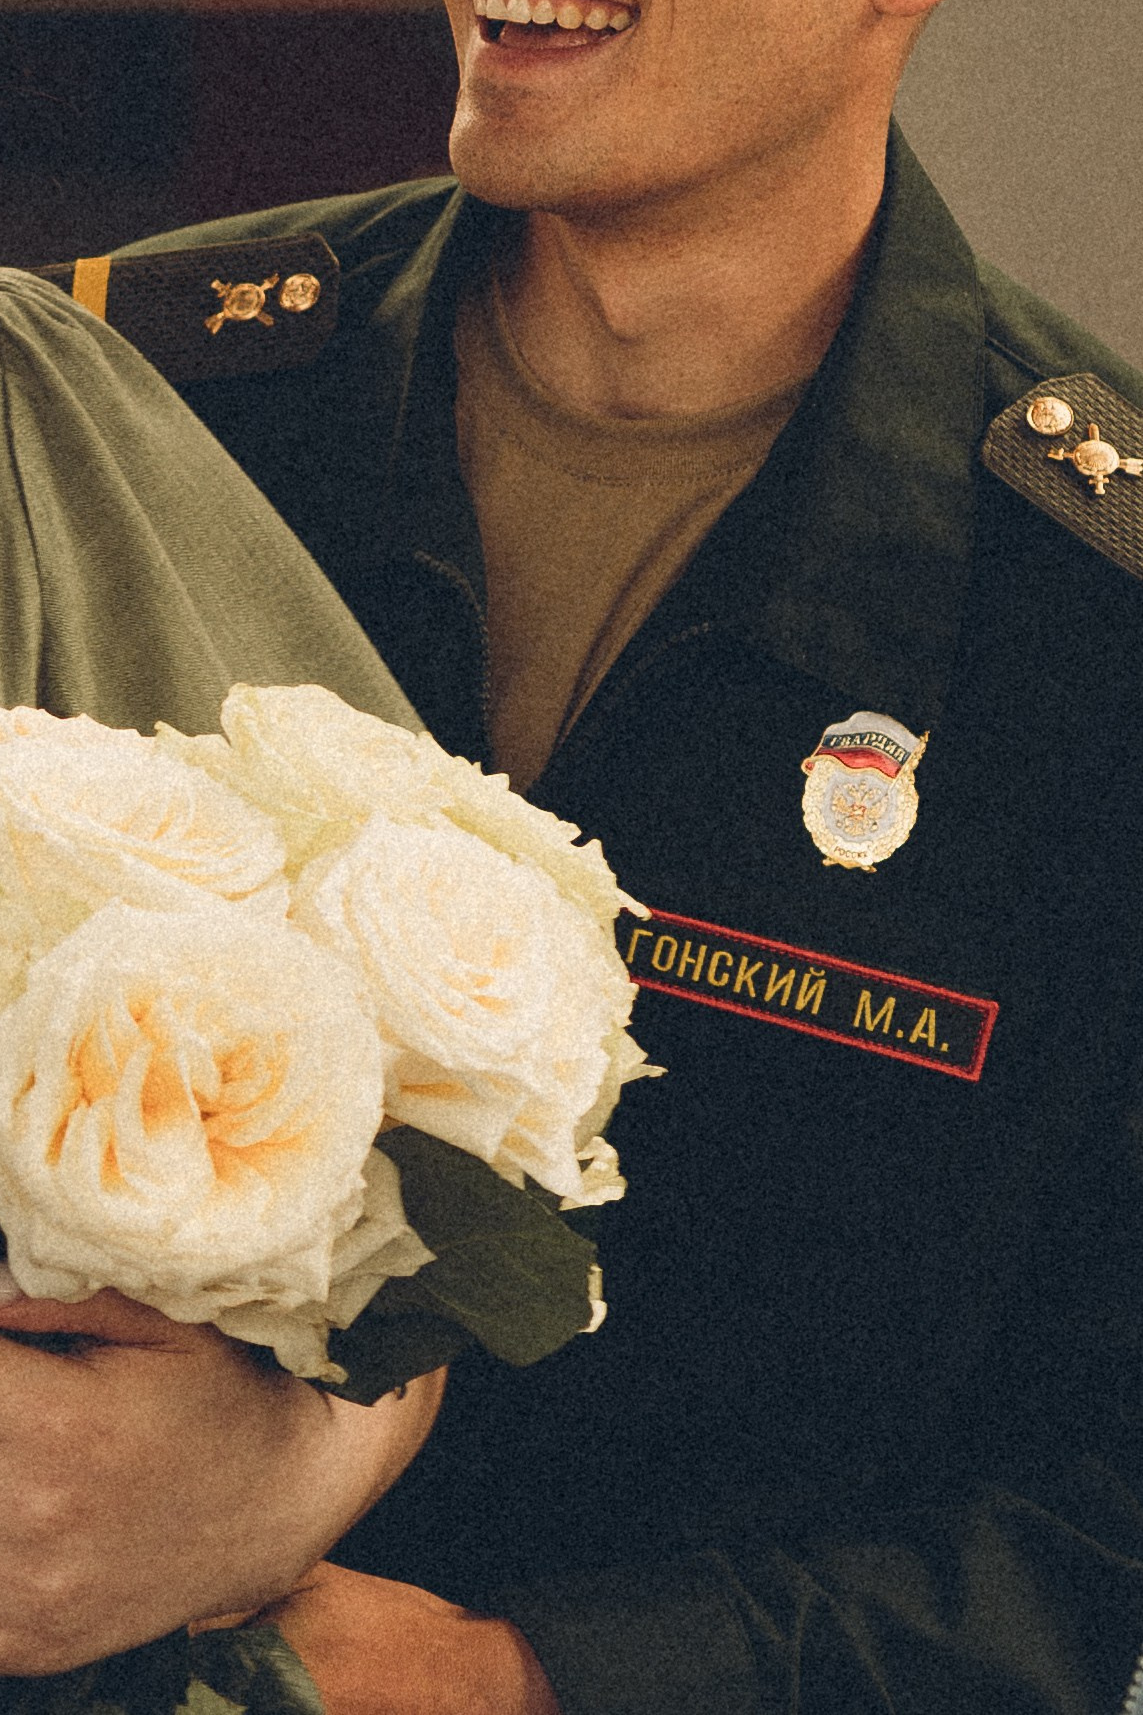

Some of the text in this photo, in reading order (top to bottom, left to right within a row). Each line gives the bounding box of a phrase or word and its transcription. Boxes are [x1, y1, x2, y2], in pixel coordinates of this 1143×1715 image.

[830, 732, 907, 763] ГВАРДИЯ
[626, 929, 950, 1052] ГОНСКИЙ М.А.
